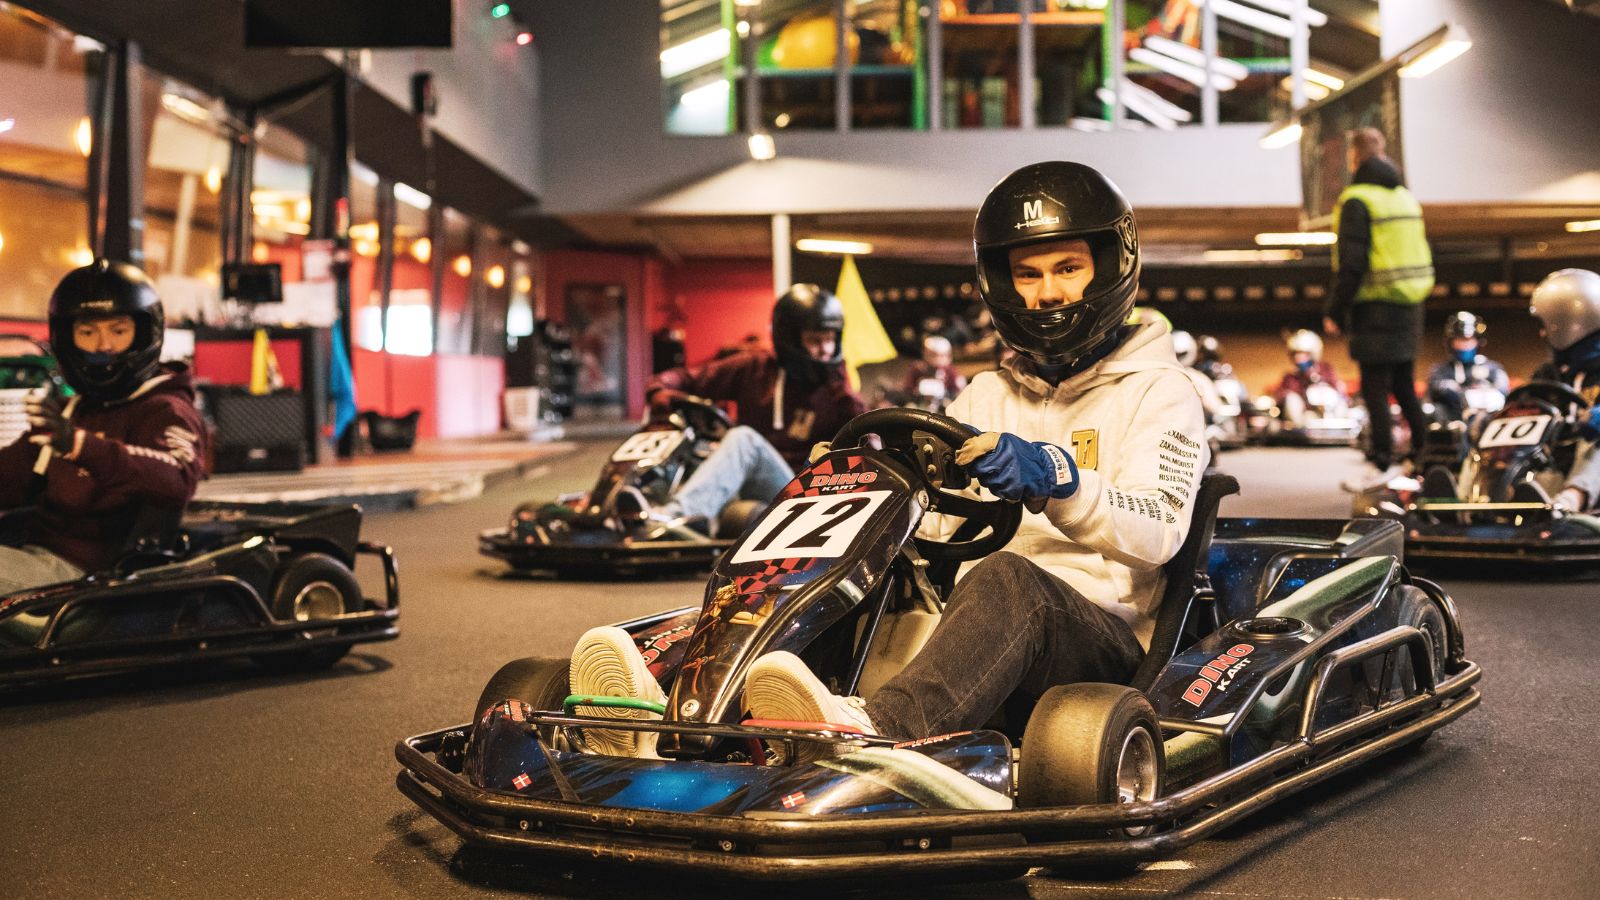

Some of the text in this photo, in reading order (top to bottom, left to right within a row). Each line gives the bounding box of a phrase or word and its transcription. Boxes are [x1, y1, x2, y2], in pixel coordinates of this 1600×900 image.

[1023, 199, 1043, 220] M
[1491, 421, 1538, 440] 10
[810, 471, 878, 488] DINO
[821, 484, 857, 492] KART
[751, 497, 872, 552] 12
[1181, 643, 1255, 708] DINO
[1216, 657, 1252, 692] KART
